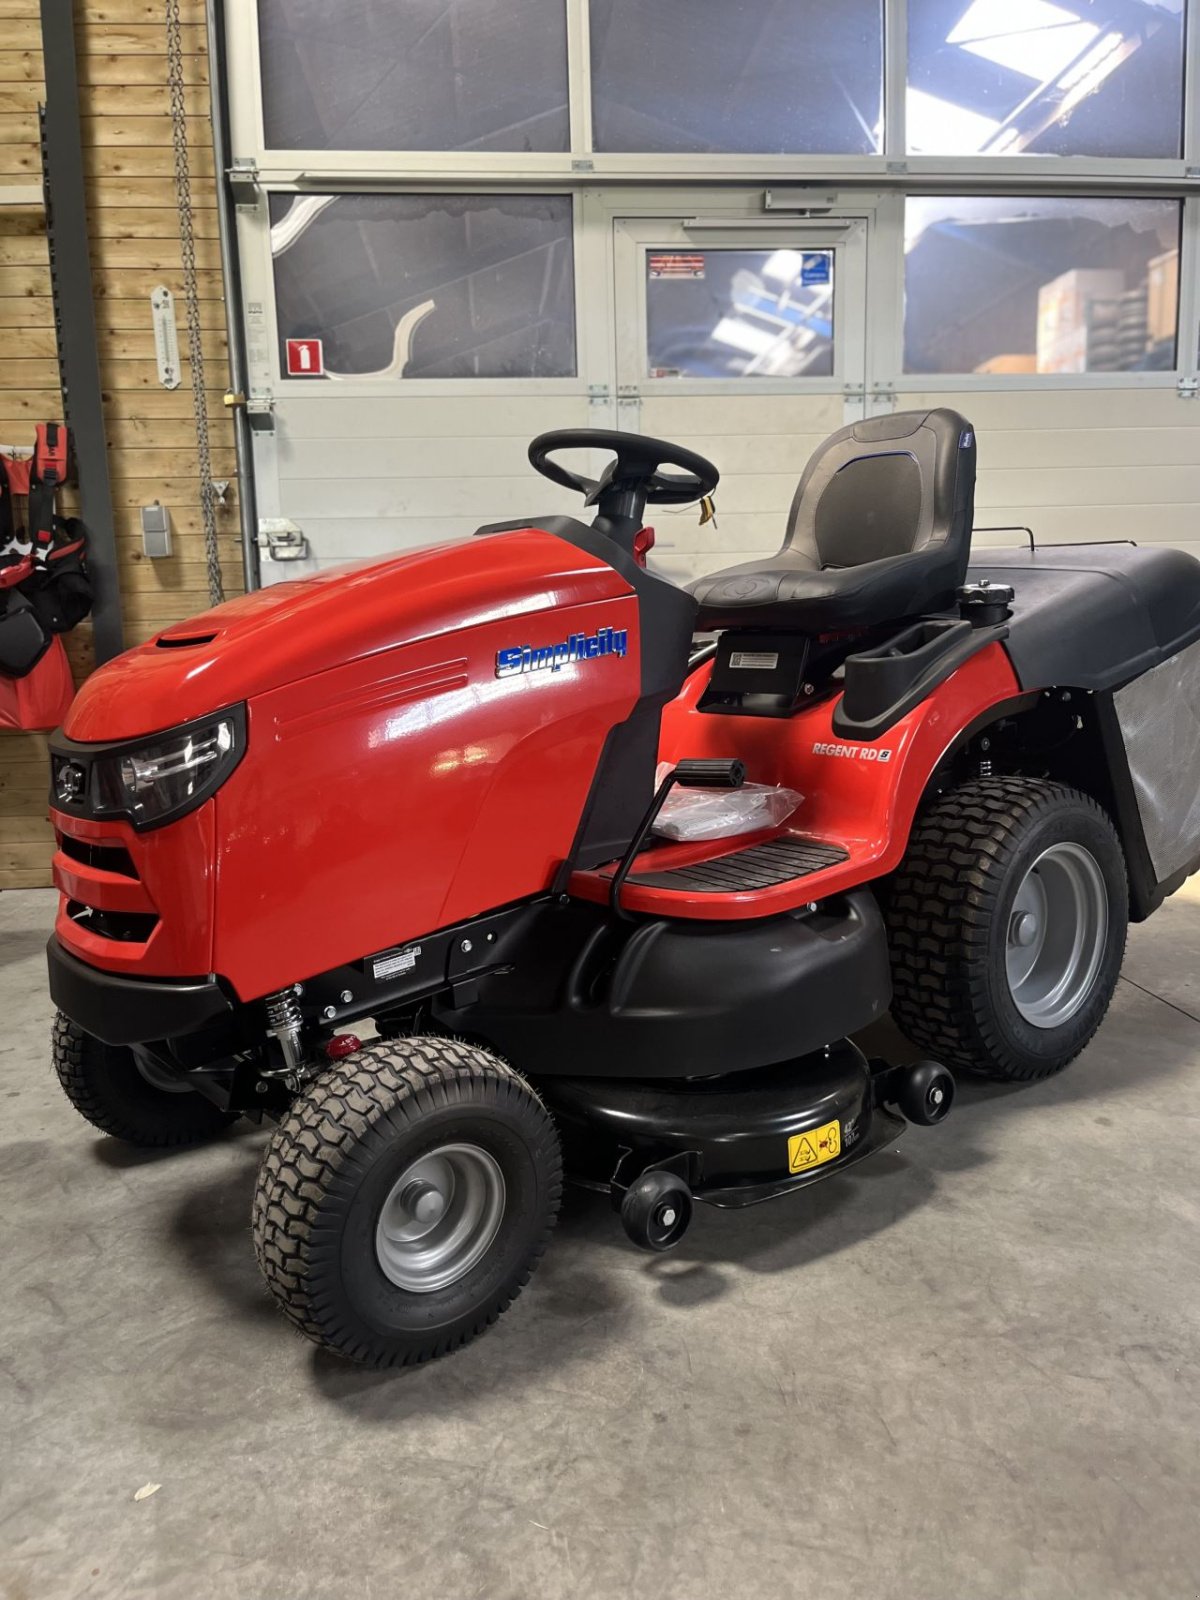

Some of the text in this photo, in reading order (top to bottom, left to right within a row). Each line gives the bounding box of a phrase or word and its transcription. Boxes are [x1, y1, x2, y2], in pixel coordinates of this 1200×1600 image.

[495, 626, 628, 679] Simplicity
[812, 742, 859, 758] REGENT
[859, 747, 878, 760] RD
